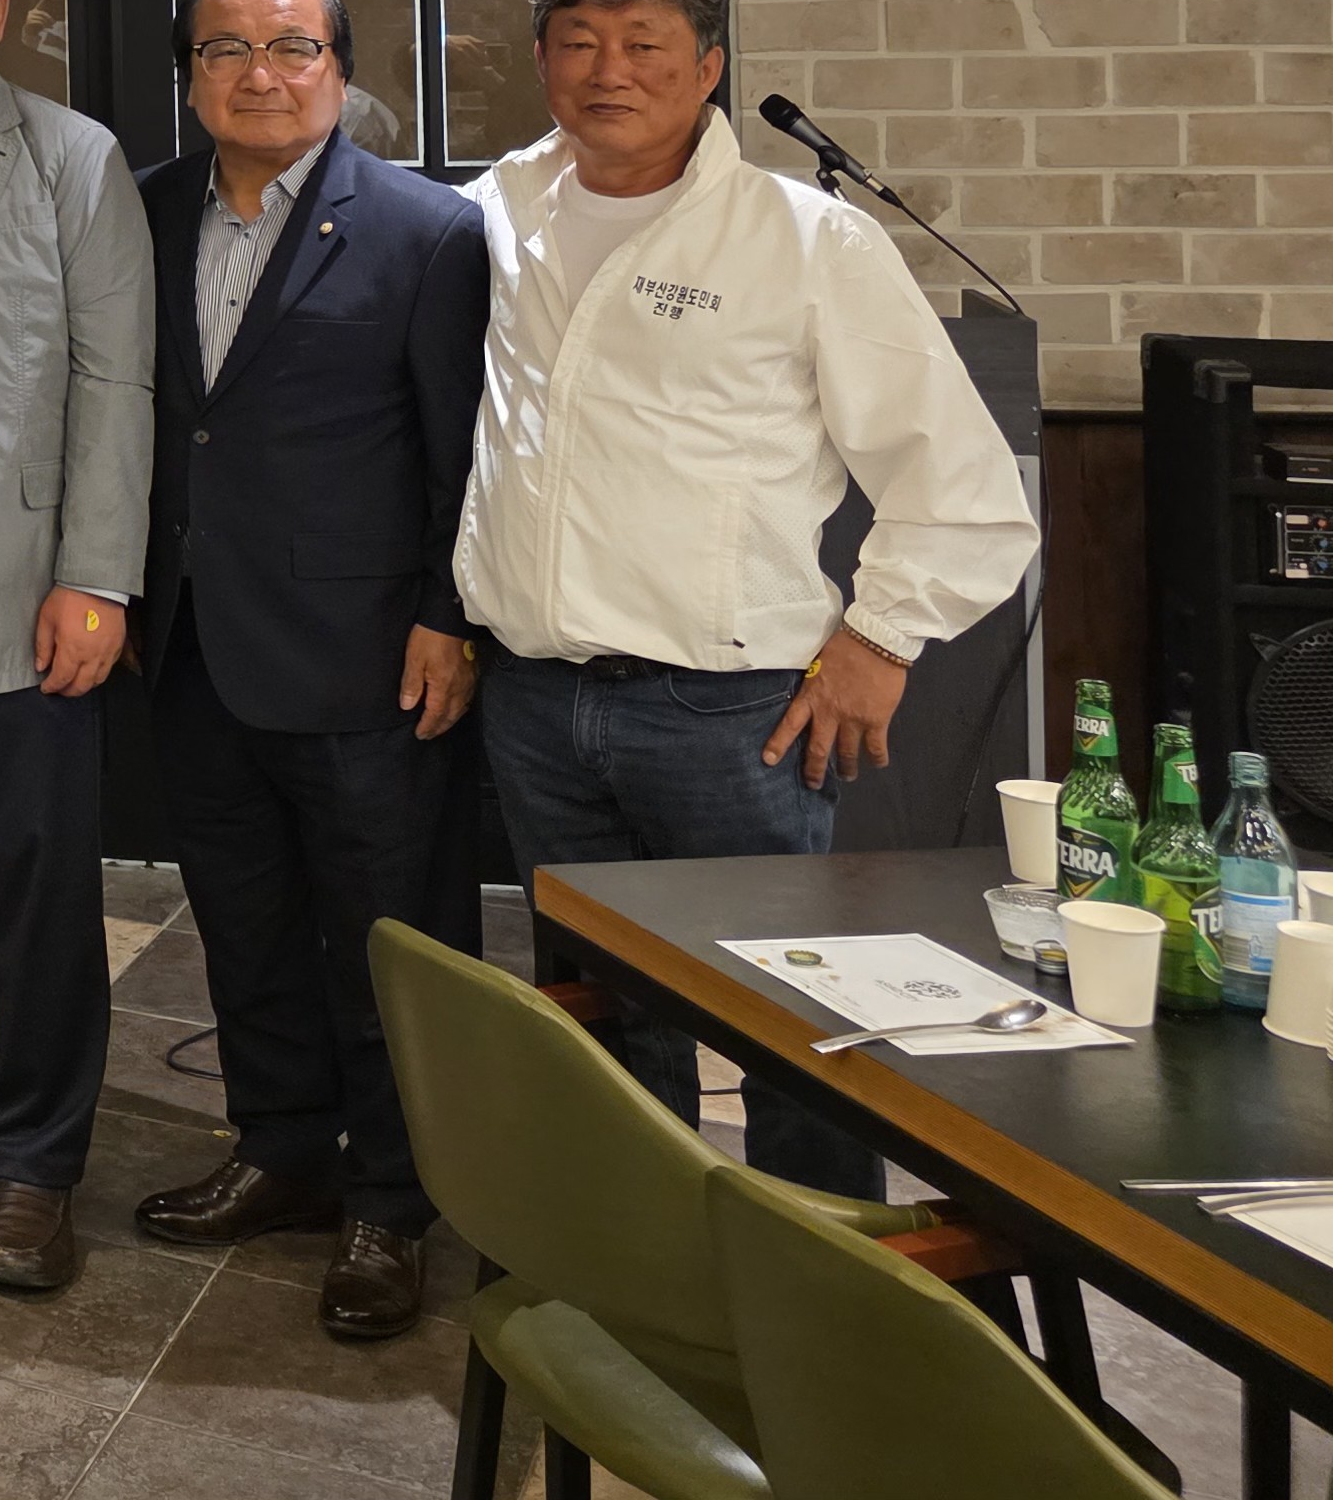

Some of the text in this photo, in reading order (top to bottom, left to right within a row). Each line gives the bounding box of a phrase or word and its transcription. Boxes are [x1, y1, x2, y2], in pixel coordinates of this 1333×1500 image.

[633, 275, 722, 313] 재부산강원도민회
[653, 302, 684, 320] 진행
[1058, 840, 1116, 878] ERRA
